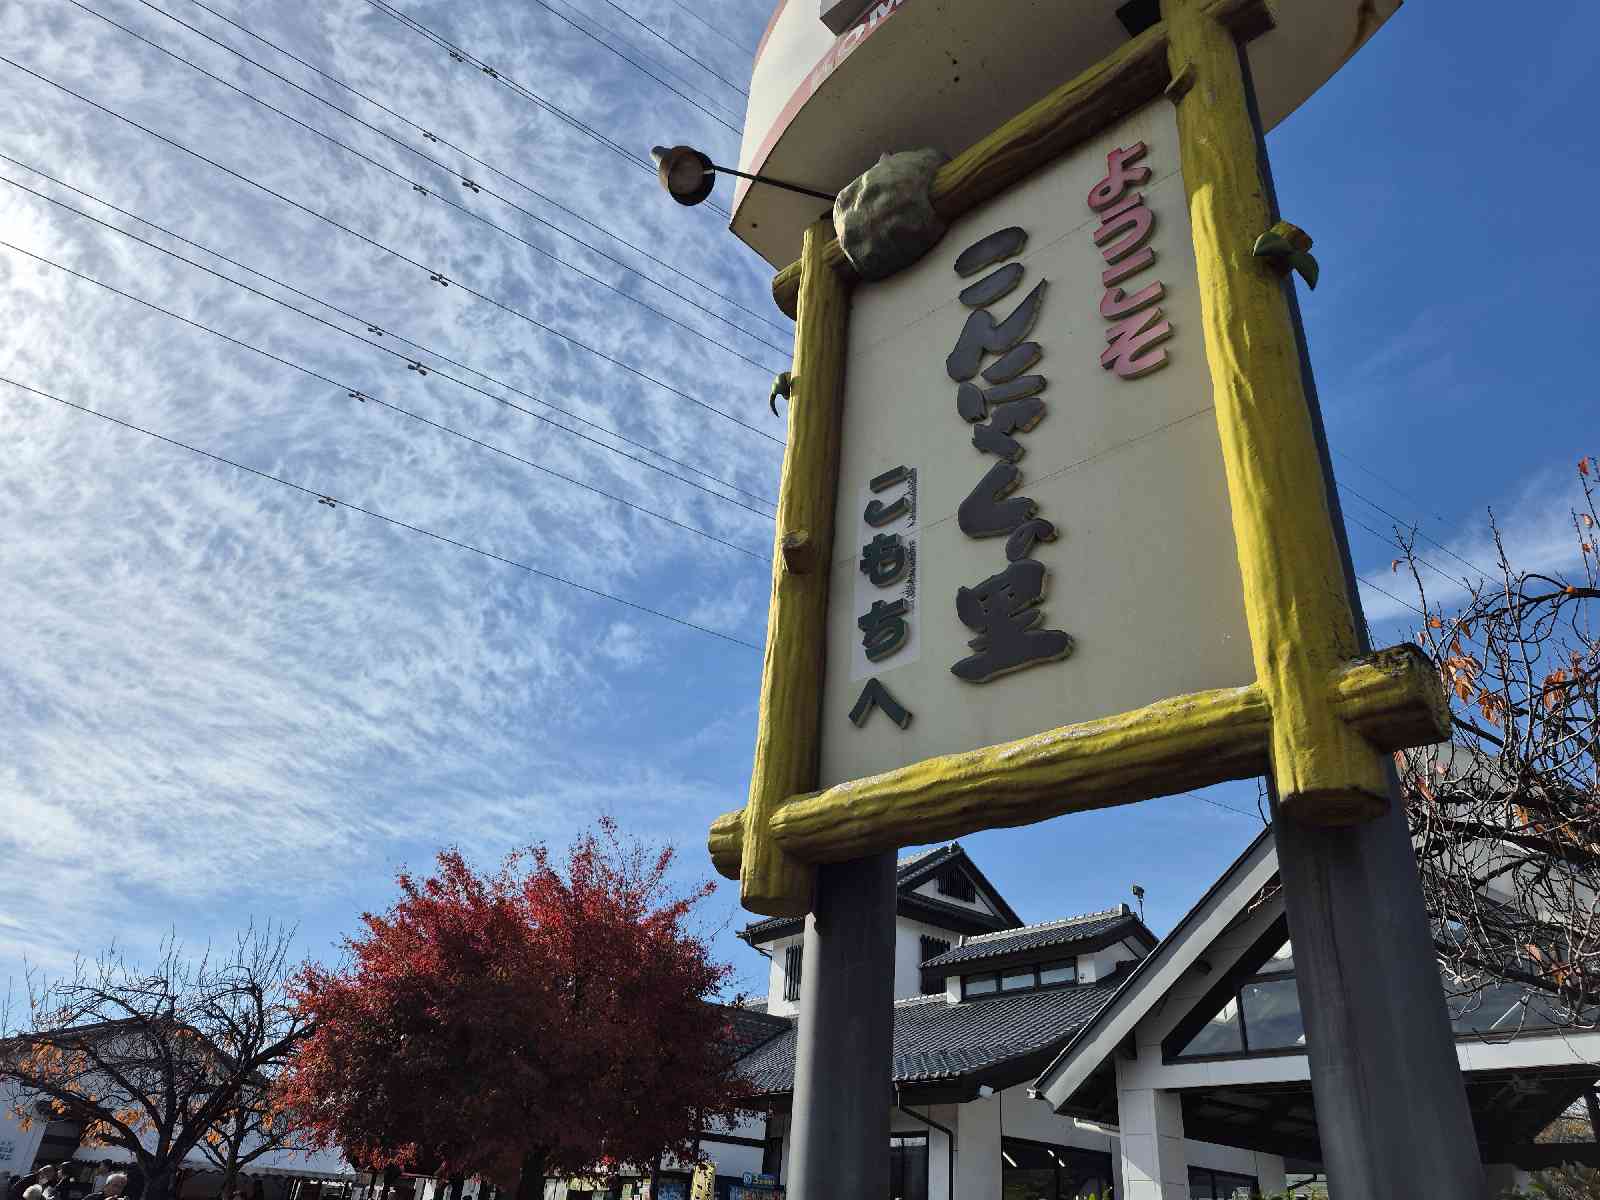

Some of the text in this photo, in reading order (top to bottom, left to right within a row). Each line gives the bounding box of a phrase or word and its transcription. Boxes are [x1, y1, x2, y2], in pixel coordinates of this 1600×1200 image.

[1088, 140, 1173, 379] ようこそ
[946, 226, 1074, 683] こんにゃくの里
